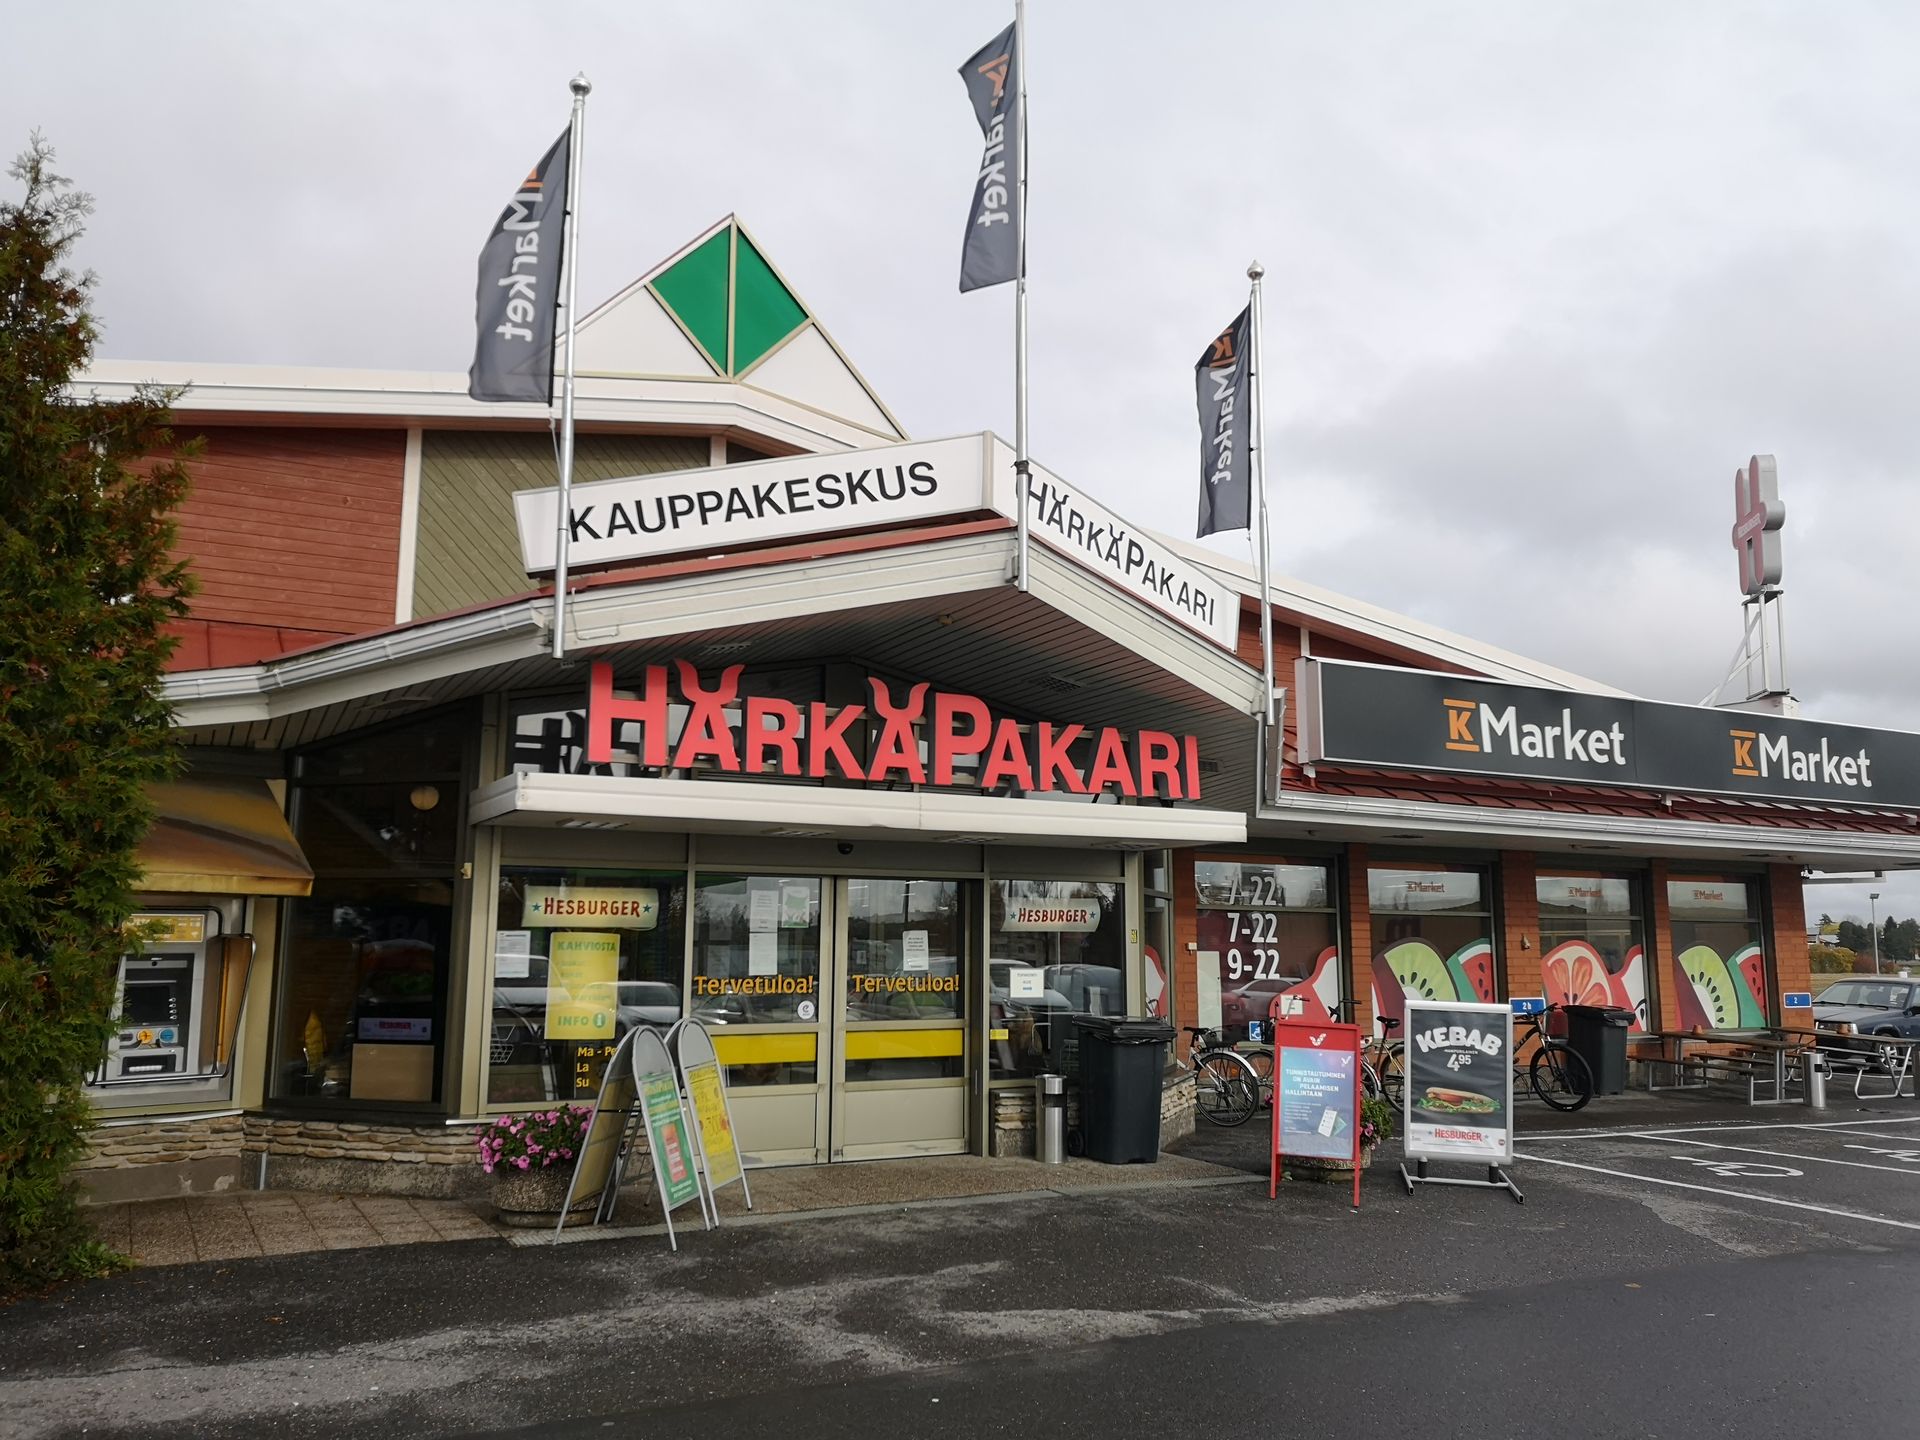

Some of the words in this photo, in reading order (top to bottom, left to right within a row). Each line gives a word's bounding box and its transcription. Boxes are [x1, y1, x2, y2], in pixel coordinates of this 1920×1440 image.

[568, 461, 938, 545] KAUPPAKESKUS
[1479, 702, 1626, 766] Market
[1759, 733, 1873, 788] Market
[544, 897, 640, 918] HESBURGER
[1018, 908, 1088, 924] HESBURGER
[1227, 912, 1278, 944] 7-22
[557, 940, 616, 952] KAHVIOSTA
[1227, 949, 1280, 980] 9-22
[694, 975, 814, 996] Tervetuloa!
[852, 974, 960, 993] Tervetuloa!
[557, 1015, 589, 1027] INFO
[1415, 1026, 1503, 1056] KEBAB
[577, 1047, 594, 1057] Ma
[576, 1062, 590, 1073] La
[576, 1077, 590, 1088] Su
[1434, 1128, 1483, 1142] HESBURGER
